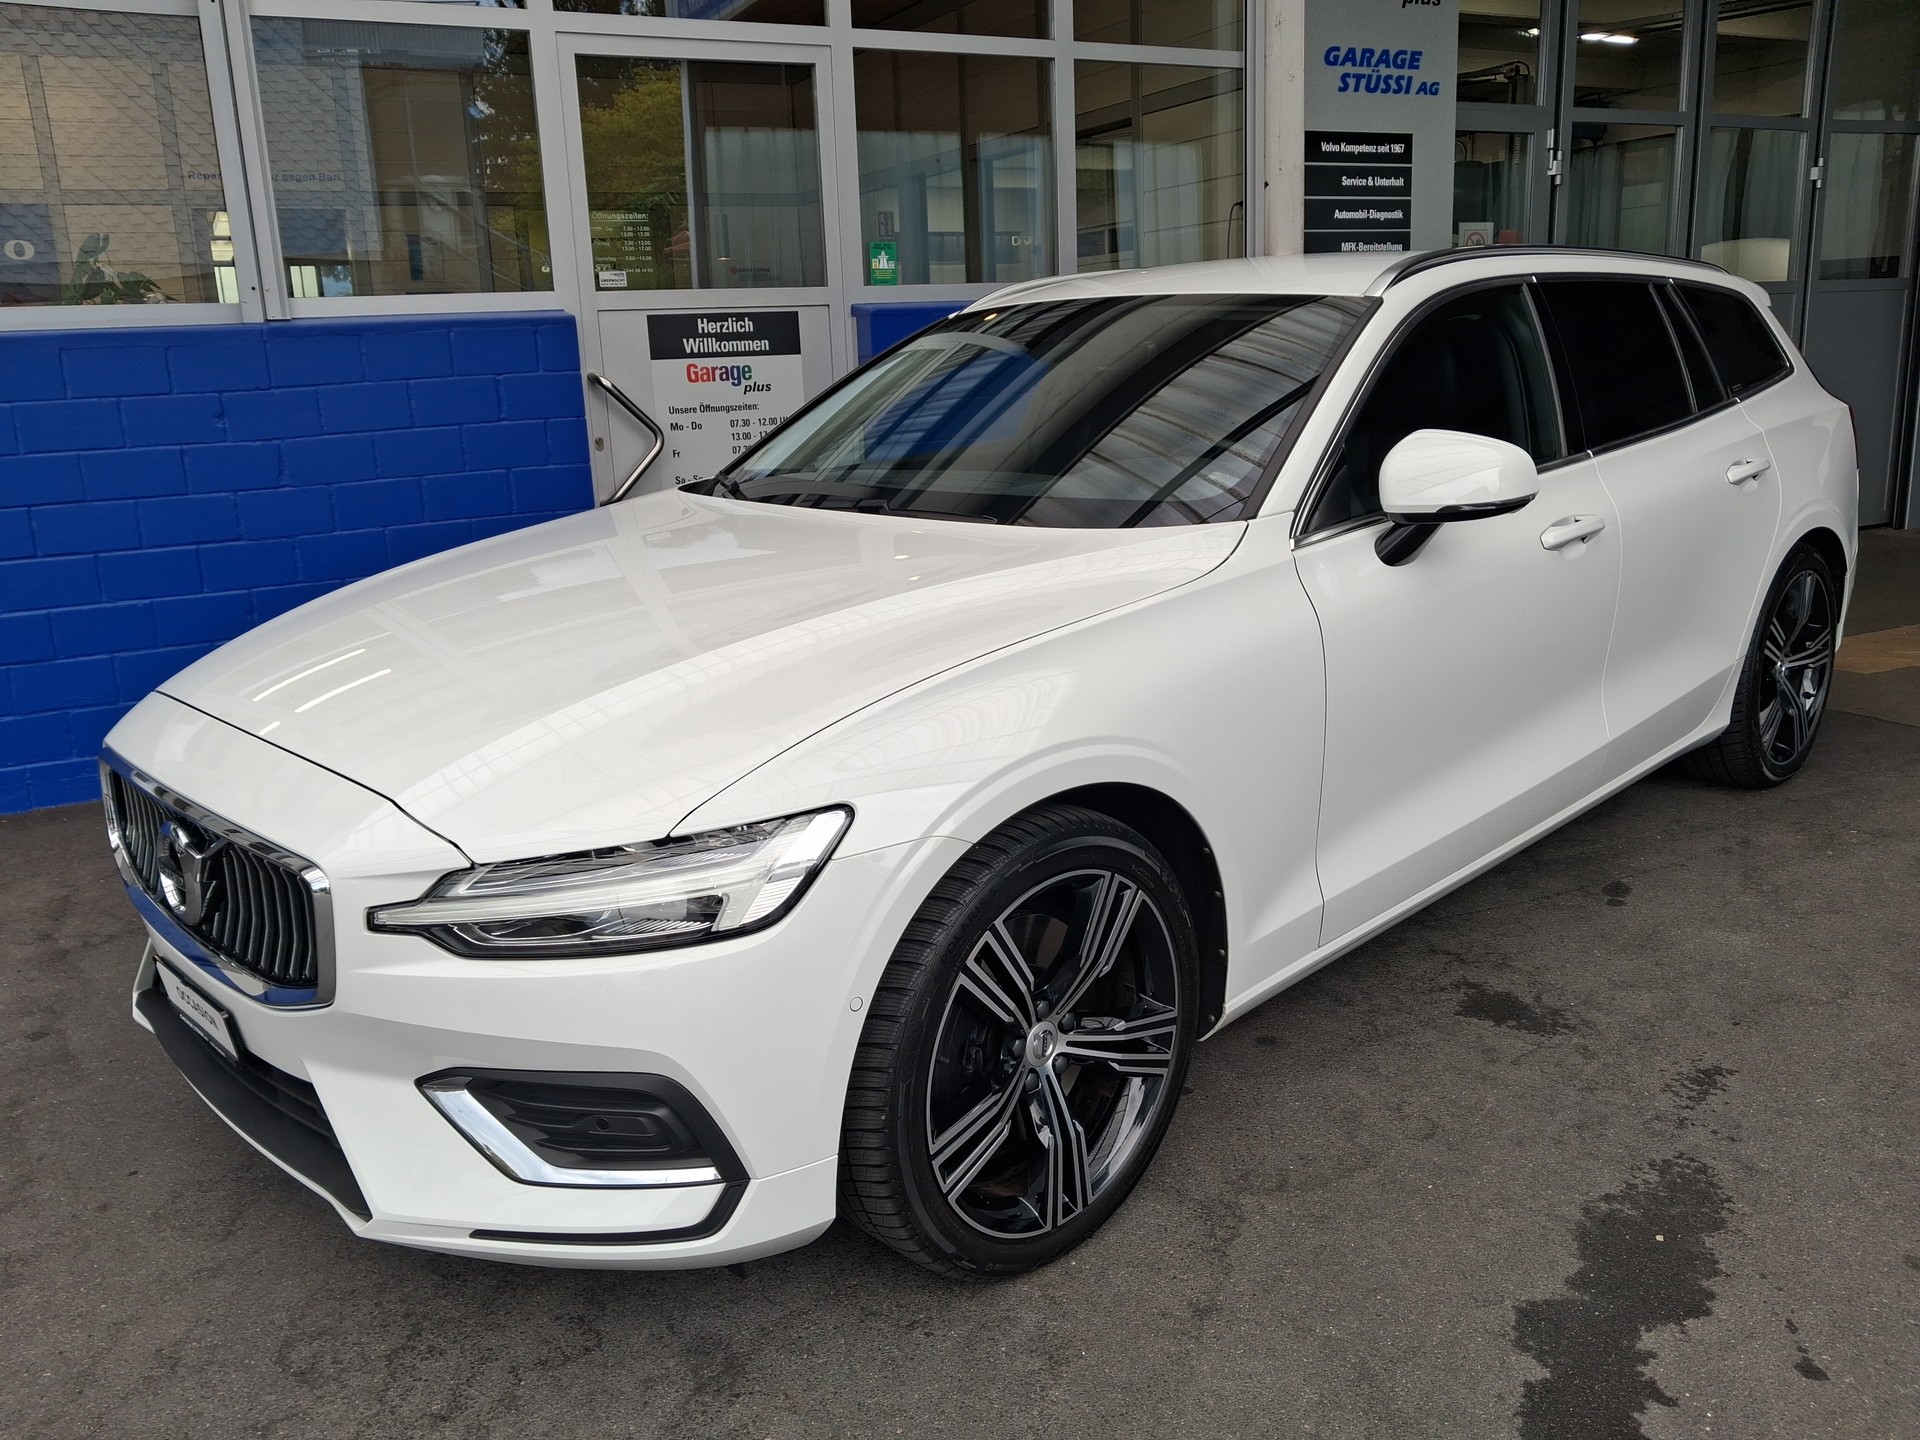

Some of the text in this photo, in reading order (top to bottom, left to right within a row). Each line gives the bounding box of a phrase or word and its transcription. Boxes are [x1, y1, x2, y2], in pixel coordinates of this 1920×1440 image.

[1324, 46, 1423, 70] GARAGE
[1338, 69, 1440, 96] STÜSSI AG
[1321, 142, 1405, 155] Volvo Kompetenz seit 1967
[1341, 175, 1404, 186] Service & Unterhalt
[1334, 209, 1404, 221] Automobil-Diagnostik
[1341, 242, 1403, 252] MFK-Bereitstellung
[697, 317, 754, 334] Herzlich
[682, 337, 770, 354] Willkommen
[686, 363, 753, 387] Garage
[743, 381, 772, 395] plus
[668, 402, 760, 415] Unsere Öffnungszeiten:
[670, 422, 684, 432] Mo
[691, 421, 703, 430] Do
[730, 418, 751, 428] 07.30
[758, 417, 778, 426] 12.00
[731, 431, 752, 441] 13.00
[672, 449, 681, 458] Fr
[675, 475, 686, 485] Sa
